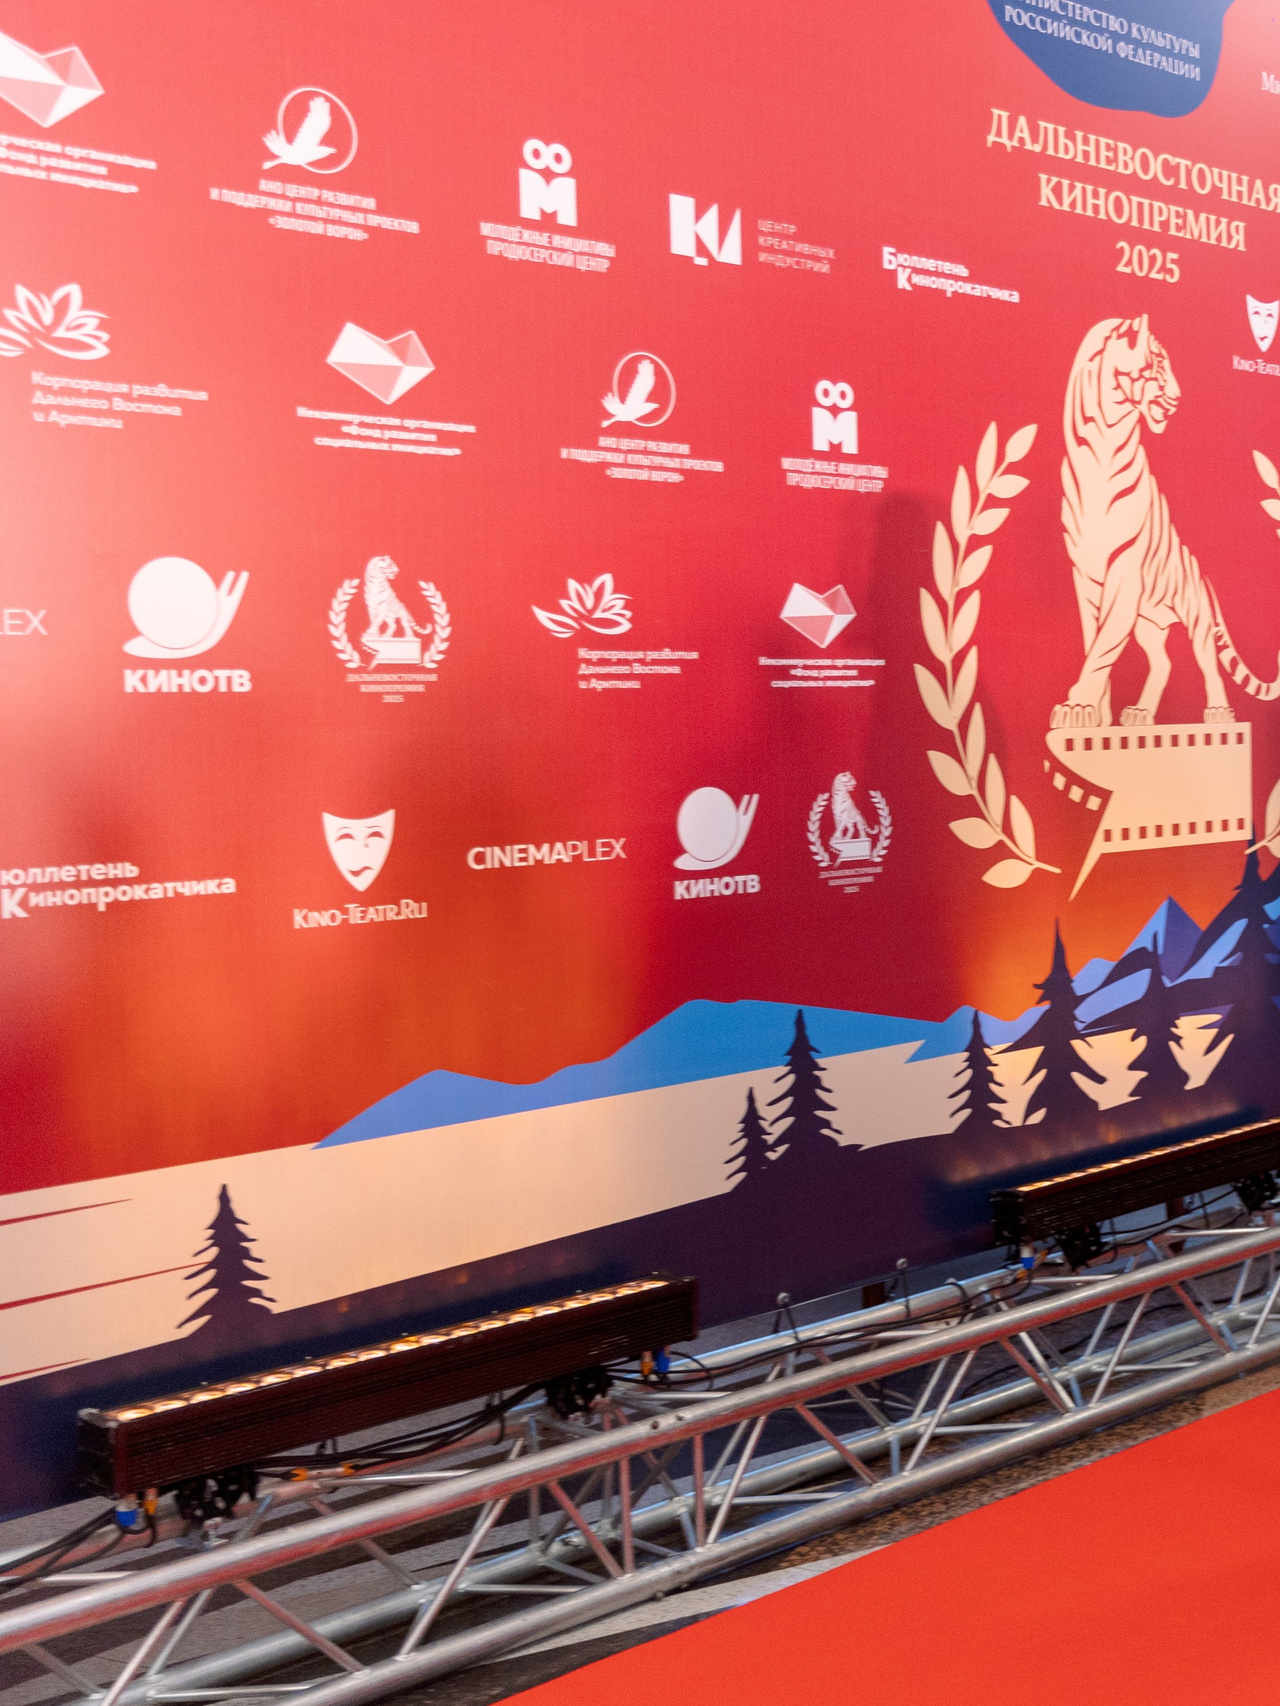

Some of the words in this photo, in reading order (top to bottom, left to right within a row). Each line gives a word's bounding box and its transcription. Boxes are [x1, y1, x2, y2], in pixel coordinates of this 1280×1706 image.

[1004, 5, 1113, 53] РОССИЙСКОЙ
[1116, 41, 1200, 81] ФЕДЕРАЦИИ
[1131, 23, 1200, 58] КУЛЬТУРЫ
[757, 219, 799, 235] ЦЕНТР
[1038, 173, 1247, 251] КИНОПРЕМИЯ
[882, 246, 970, 278] Бюллетень
[1115, 241, 1180, 283] 2025
[896, 266, 1020, 304] Кинопрокатчика
[123, 669, 253, 694] КИНОТВ
[467, 838, 627, 870] CINEMAPLEX
[0, 862, 140, 886] юллетень
[673, 874, 761, 900] КИНОТВ
[1, 877, 237, 919] Кинопрокатчика
